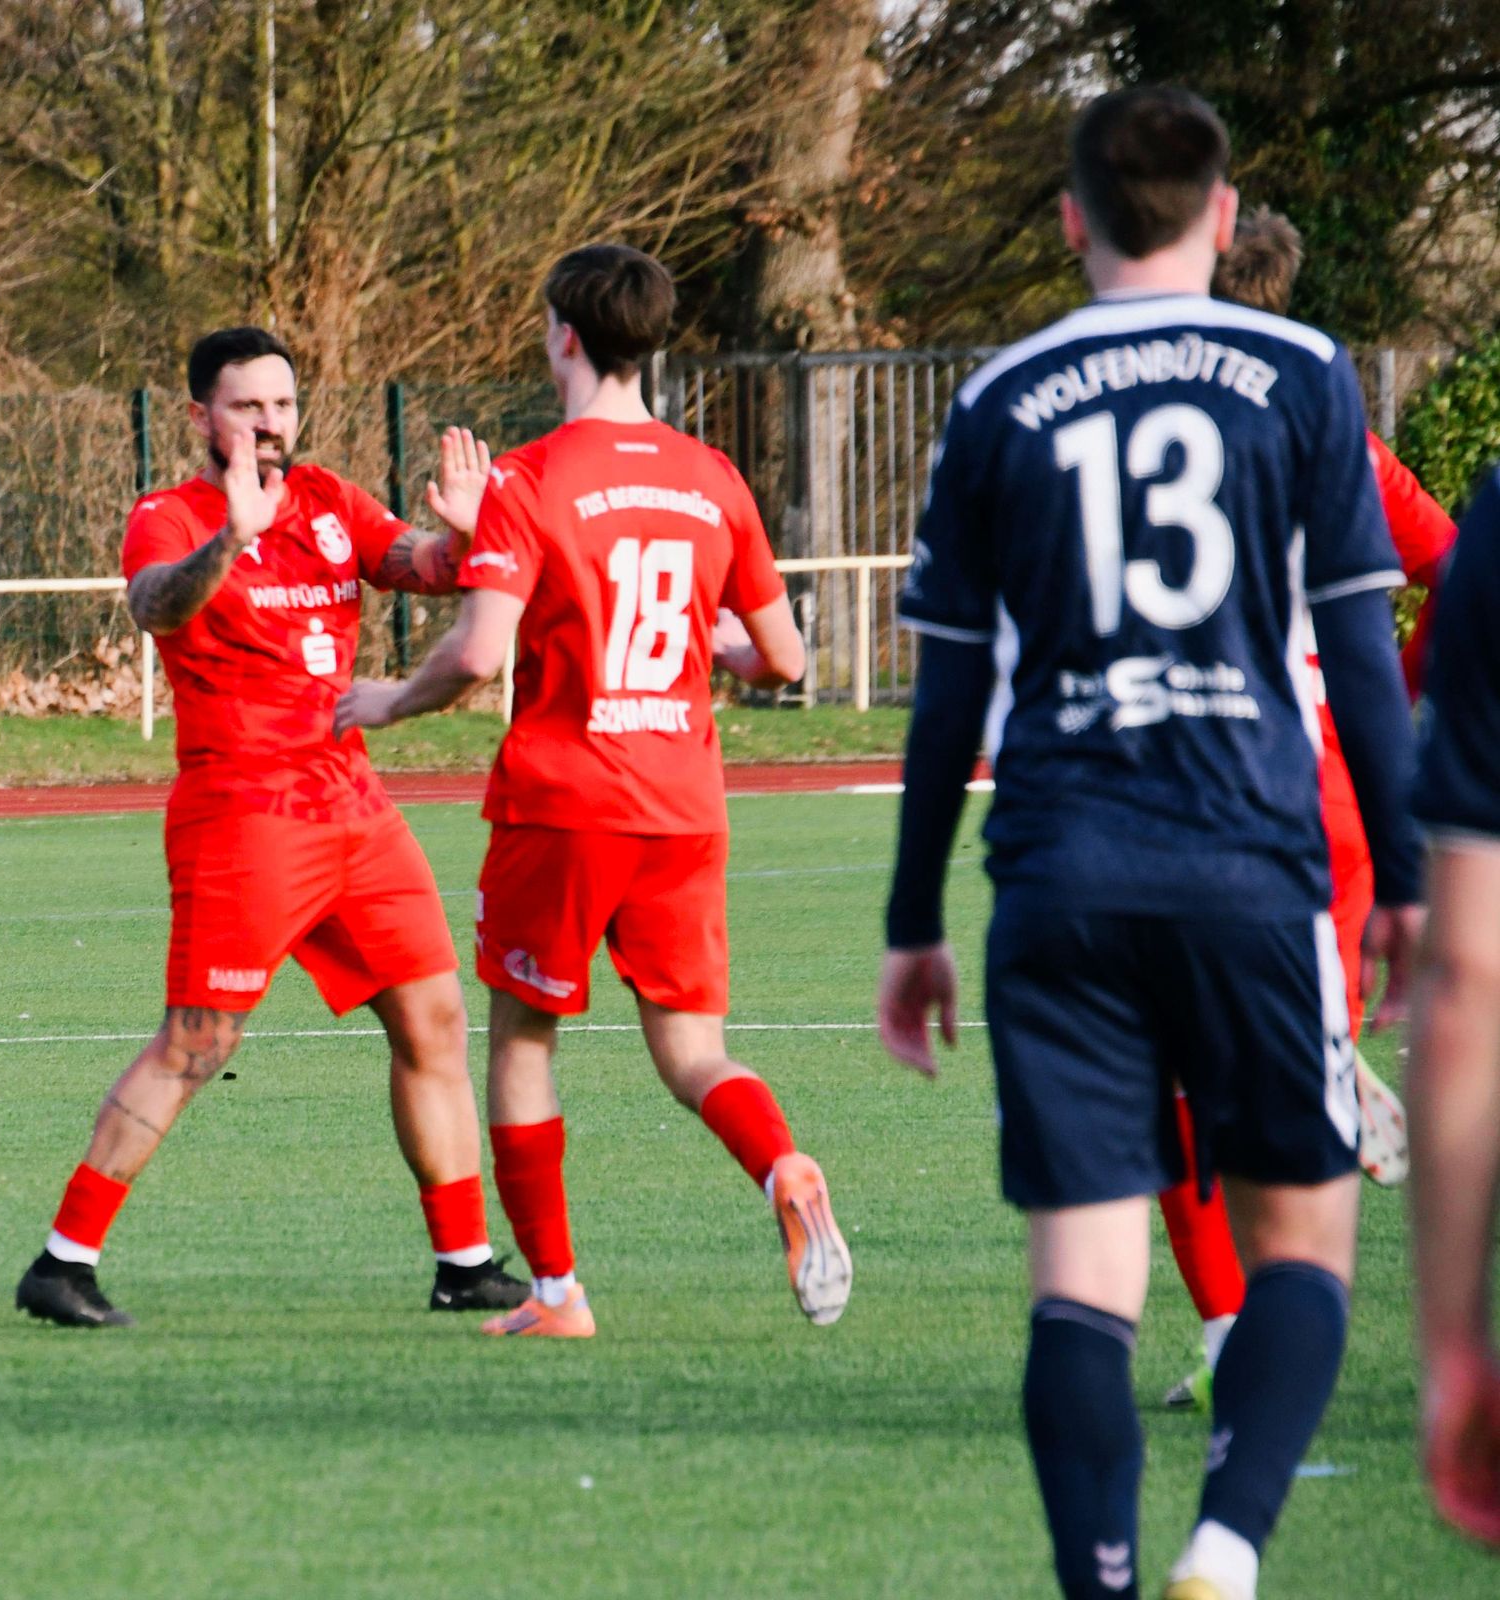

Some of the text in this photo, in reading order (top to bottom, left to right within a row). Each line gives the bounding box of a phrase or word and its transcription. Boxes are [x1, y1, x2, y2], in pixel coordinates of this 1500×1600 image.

[1008, 333, 1280, 431] WOLFENBÜTTEL
[1054, 402, 1236, 638] 13
[247, 586, 290, 609] WIR
[289, 583, 332, 609] FÜR
[605, 537, 693, 692] 18
[587, 697, 692, 733] SCHMIDT
